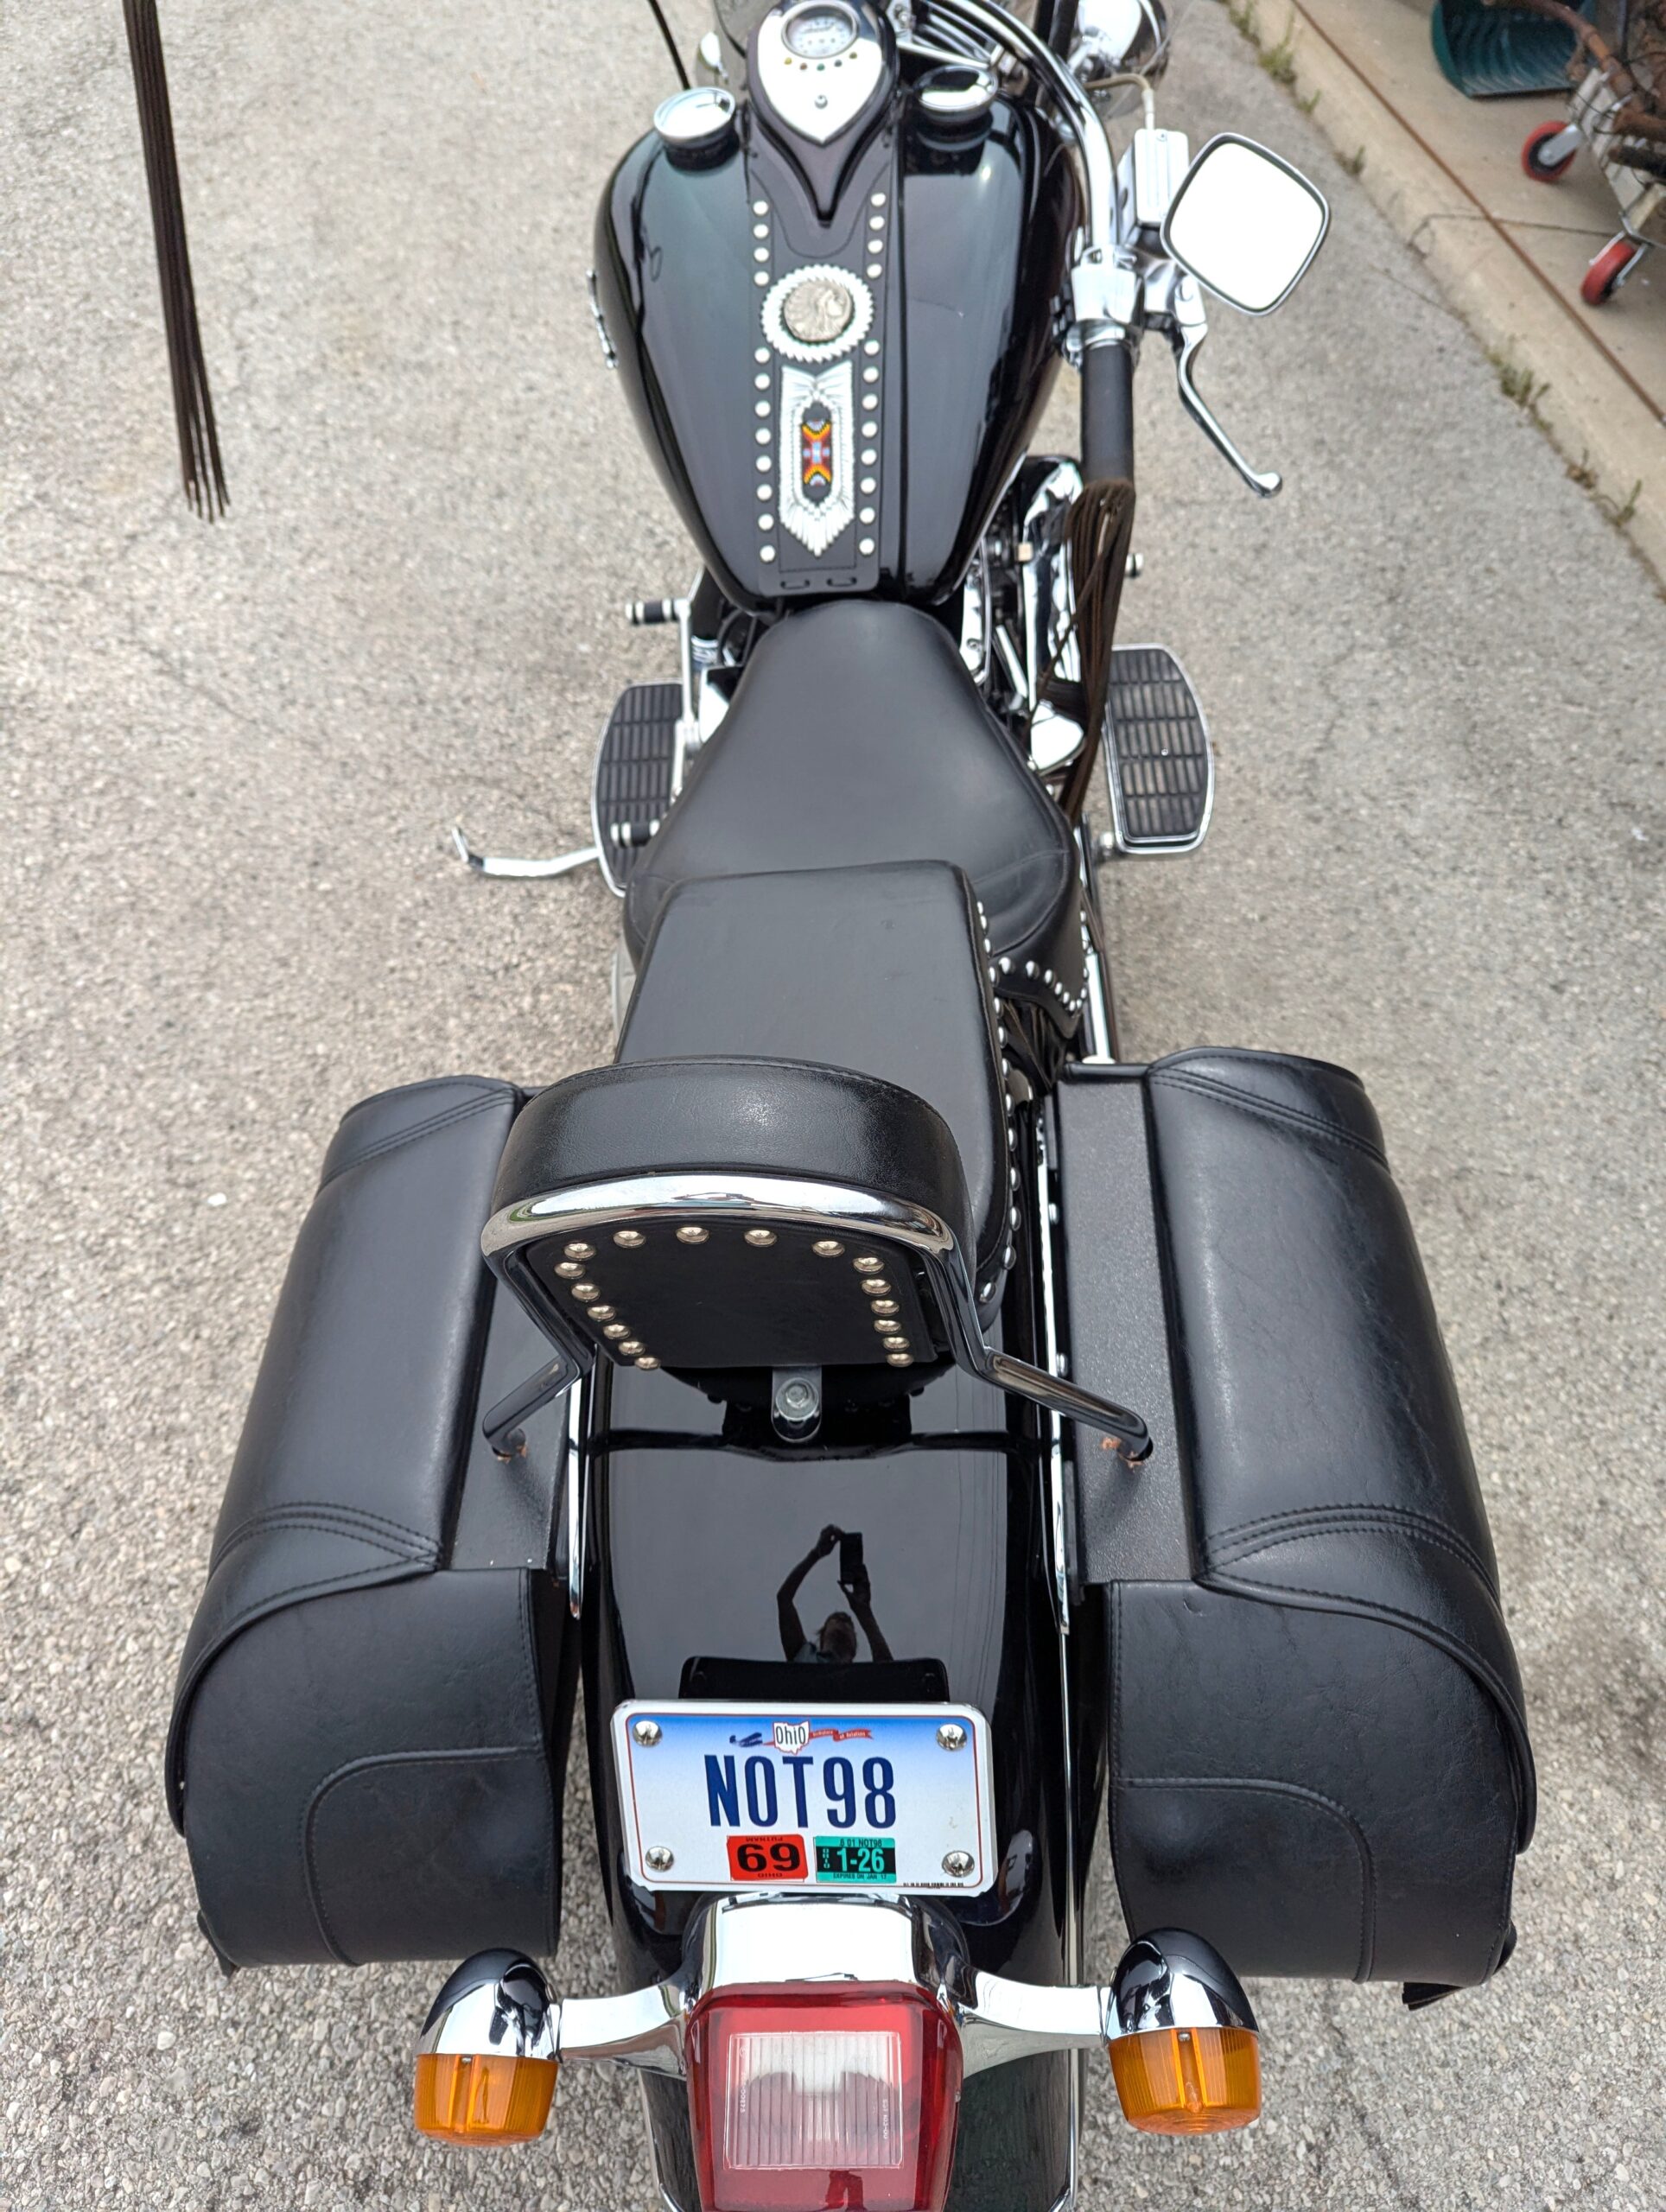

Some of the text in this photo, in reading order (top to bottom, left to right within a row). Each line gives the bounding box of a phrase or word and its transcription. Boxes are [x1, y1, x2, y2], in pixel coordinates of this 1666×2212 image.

[704, 1754, 896, 1828] NOT98
[737, 1842, 800, 1872] 69
[858, 1839, 882, 1847] NOT98
[836, 1847, 885, 1873] 1-26
